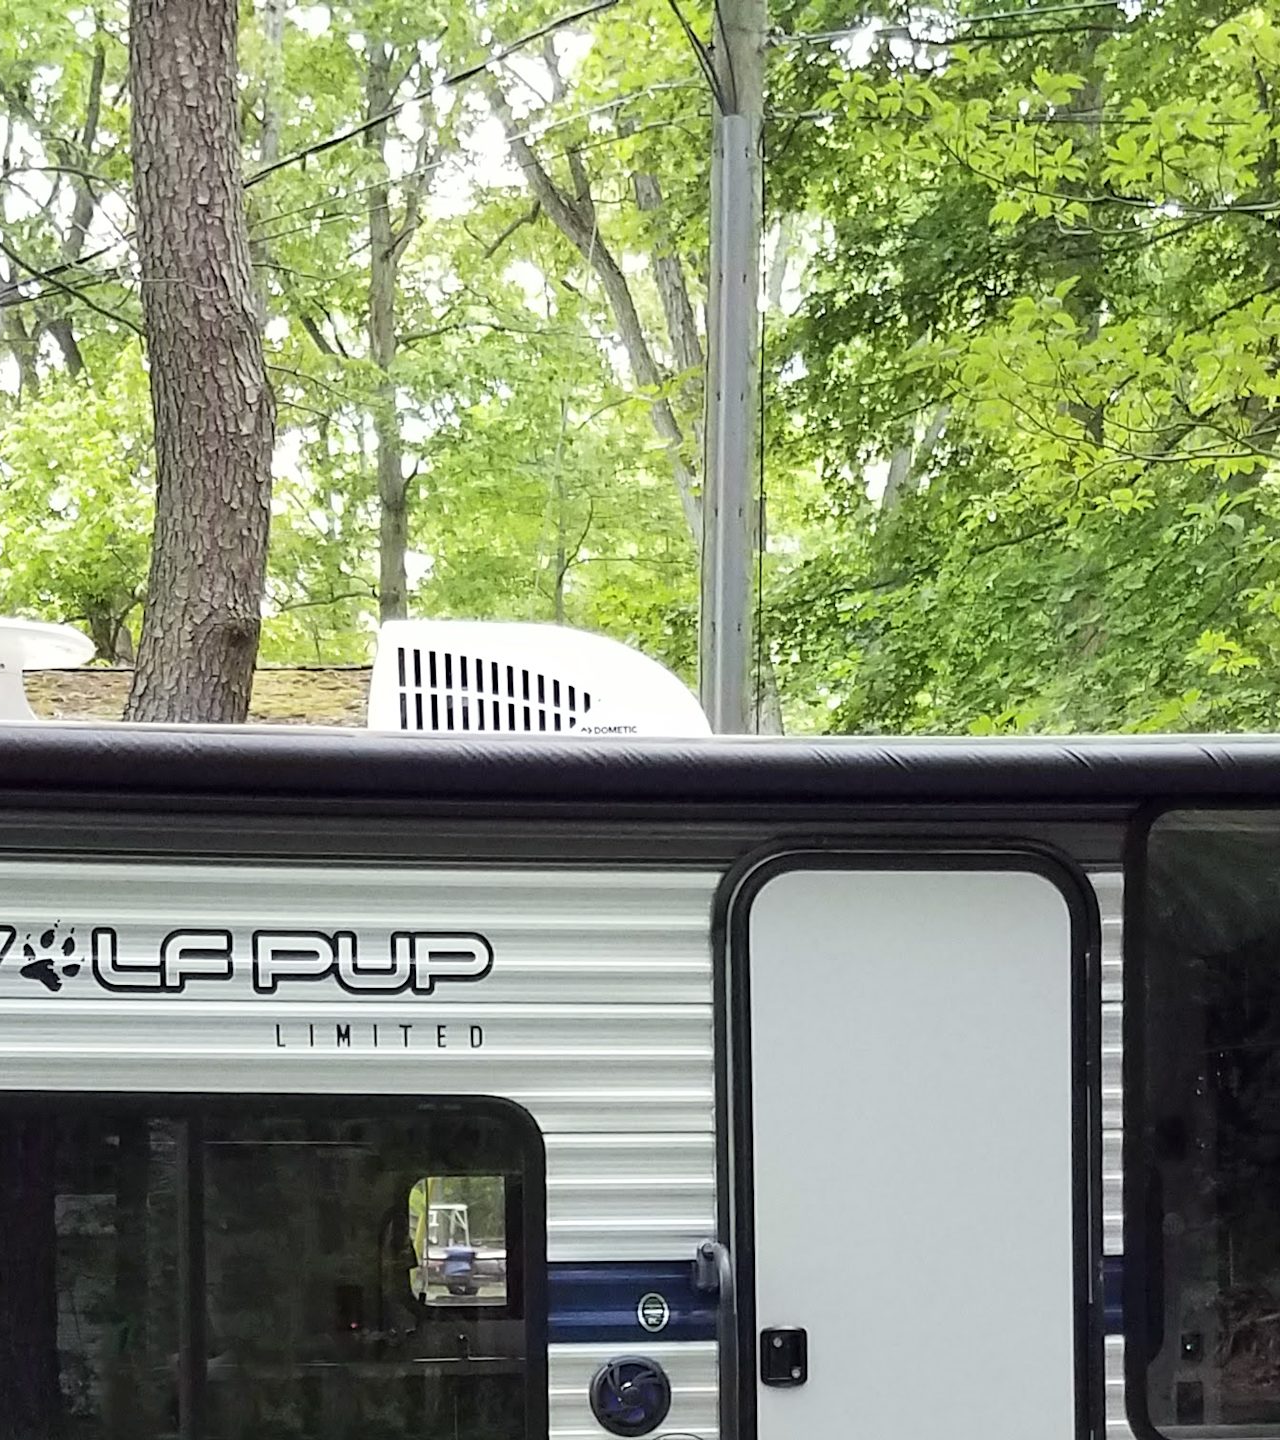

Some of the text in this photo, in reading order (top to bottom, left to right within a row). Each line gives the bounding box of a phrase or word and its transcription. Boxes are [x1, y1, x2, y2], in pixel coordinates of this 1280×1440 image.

[593, 725, 638, 735] DOMETIC
[253, 929, 494, 996] PUP
[275, 1022, 484, 1050] LIMITED
